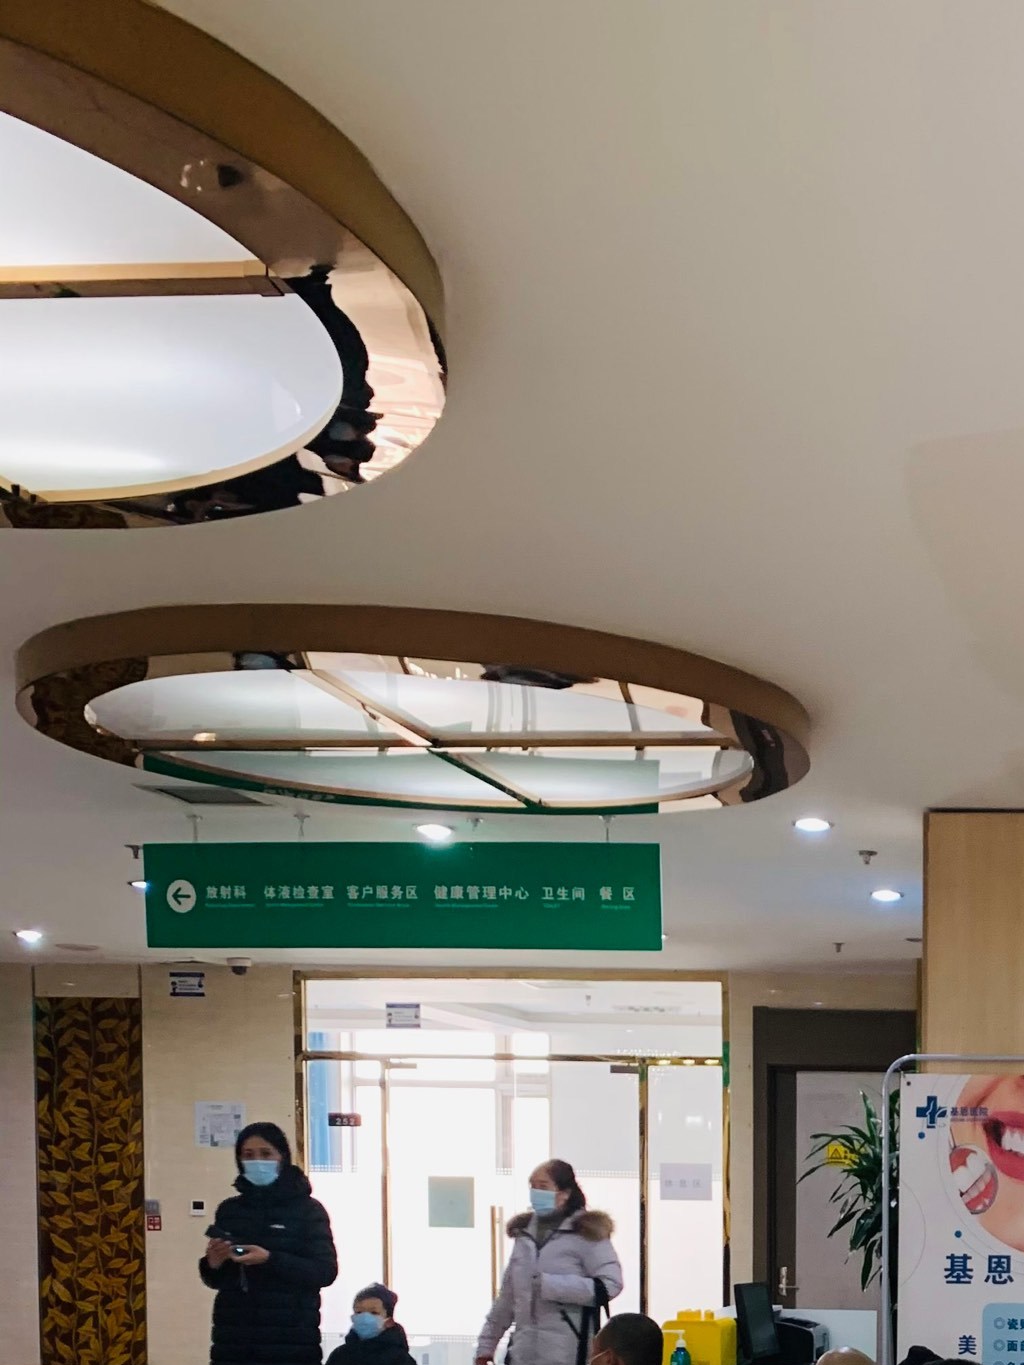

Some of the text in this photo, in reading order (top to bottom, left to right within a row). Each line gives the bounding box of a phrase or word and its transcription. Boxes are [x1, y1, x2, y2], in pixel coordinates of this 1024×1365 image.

[205, 885, 247, 900] 放射科
[263, 885, 335, 900] 体液检查室
[346, 885, 418, 900] 客户服务区
[433, 885, 530, 901] 健康管理中心
[541, 886, 586, 901] 卫生间
[335, 1117, 355, 1125] 252
